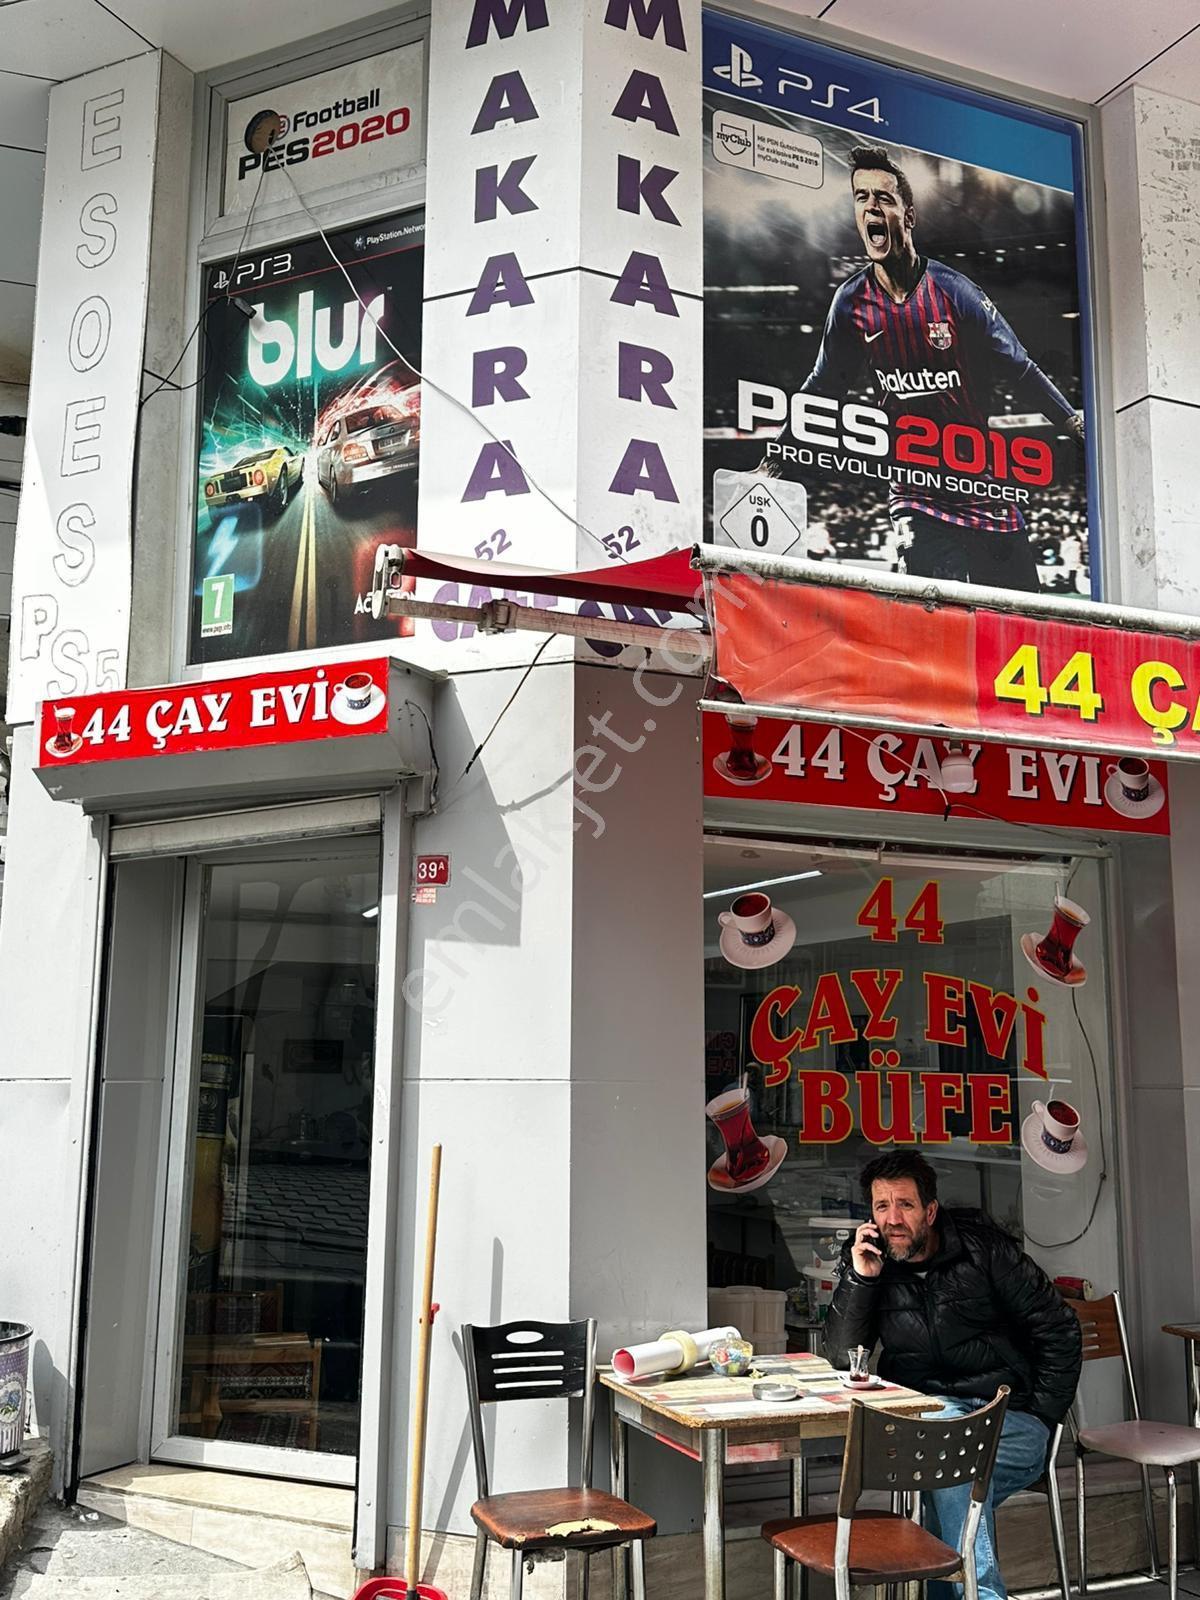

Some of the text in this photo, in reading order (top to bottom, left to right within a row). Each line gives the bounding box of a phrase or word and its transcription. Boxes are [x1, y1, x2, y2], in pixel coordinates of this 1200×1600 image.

[778, 67, 885, 124] PS4
[716, 131, 752, 148] myClub
[236, 253, 293, 285] PS3
[460, 0, 550, 503] MAKARA
[604, 0, 688, 504] MAKARA
[248, 290, 385, 386] blur
[875, 367, 962, 394] Rakuten
[749, 494, 771, 508] USK
[766, 441, 1030, 505] PRO EVOLUTION SOCCER
[474, 528, 513, 561] 52
[601, 525, 641, 560] 52
[750, 514, 769, 547] 0
[211, 581, 226, 619] 7
[82, 669, 330, 750] 44 ÇAY EVİ
[994, 644, 1200, 746] 44 Ç
[771, 724, 845, 781] 44
[856, 876, 945, 945] 44
[750, 969, 903, 1087] ÇAY
[923, 971, 1049, 1081] EVİ
[799, 1048, 1013, 1146] BÜFE
